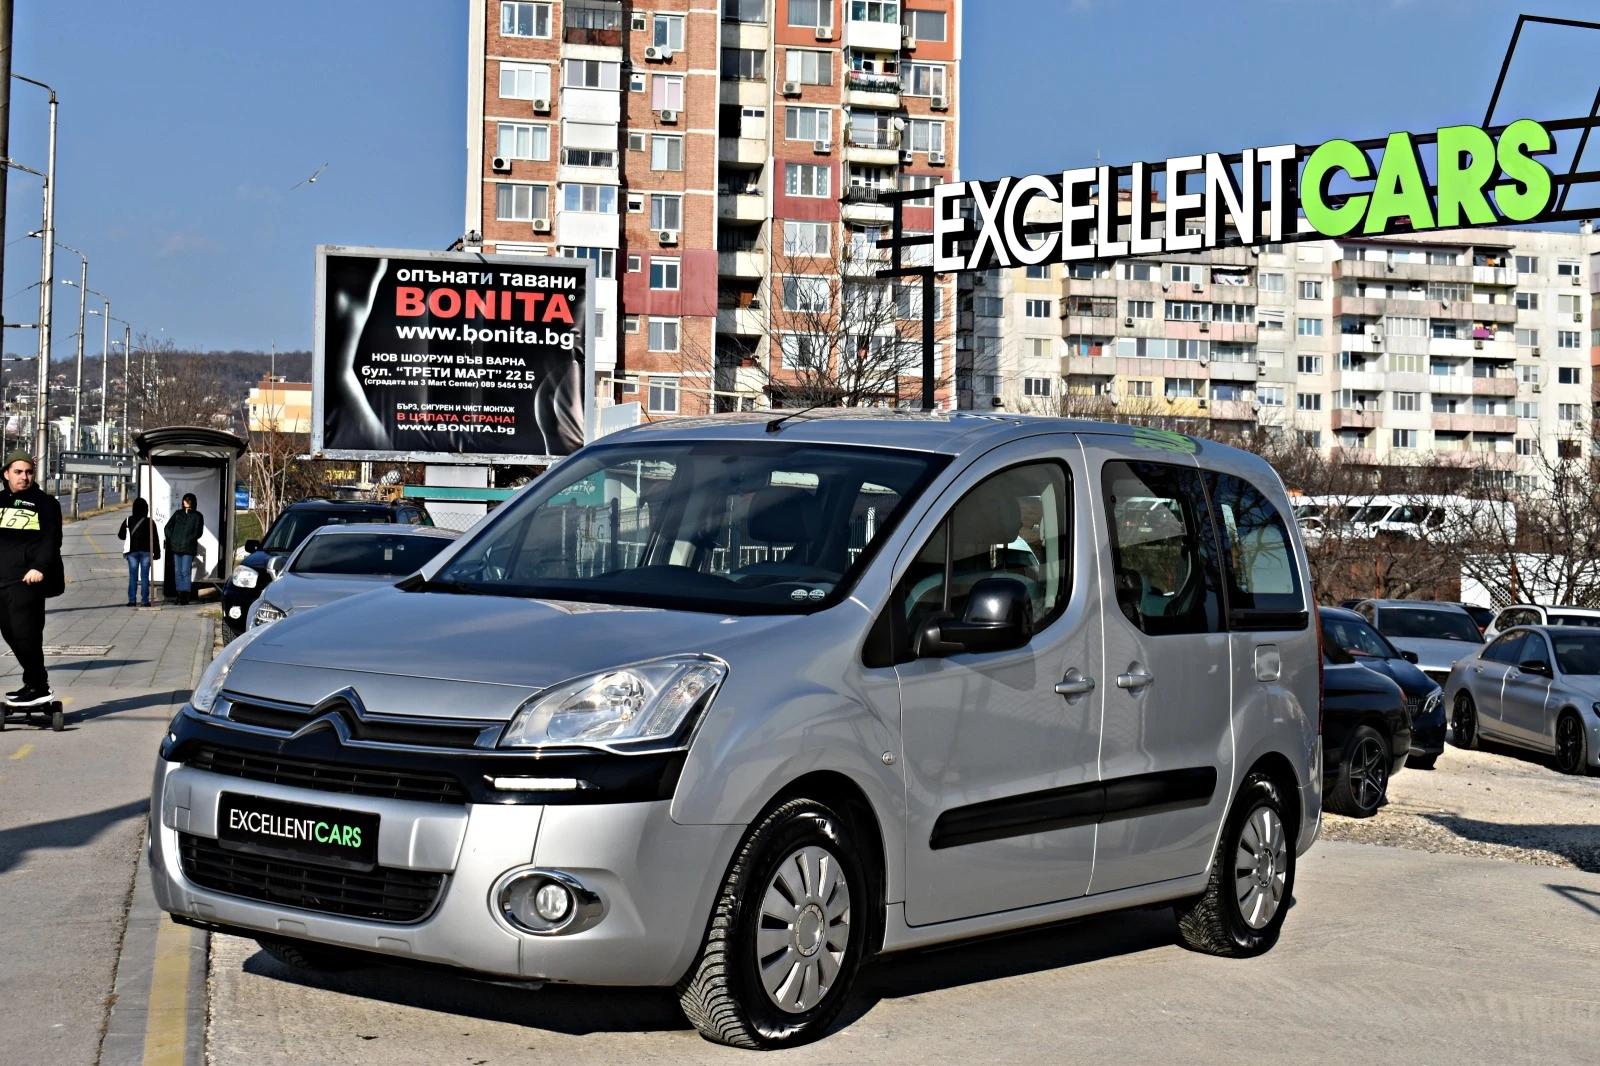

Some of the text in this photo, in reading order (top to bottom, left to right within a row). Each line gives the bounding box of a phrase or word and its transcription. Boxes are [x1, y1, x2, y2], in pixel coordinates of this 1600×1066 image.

[396, 268, 576, 290] опънати тавани
[396, 324, 575, 349] www.bonita.bg
[371, 353, 527, 367] НОВ ШОУРУМ ВЪВ ВАРНА
[361, 365, 392, 378] бул.
[505, 370, 521, 381] 22
[525, 370, 536, 381] Б
[364, 377, 406, 386] (сградата
[408, 379, 419, 387] на
[427, 379, 447, 387] Mart
[448, 379, 479, 388] Center)
[480, 380, 496, 389] 089
[497, 381, 516, 389] 5454
[518, 382, 533, 390] 934
[396, 403, 419, 411] БЪРЗ,
[421, 403, 454, 412] СИГУРЕН
[462, 404, 482, 412] ЧИСТ
[483, 405, 515, 413] МОНТАЖ
[396, 412, 515, 423] В ЦЯЛАТА СТРАНА!
[397, 423, 516, 435] www.BONITA.bg
